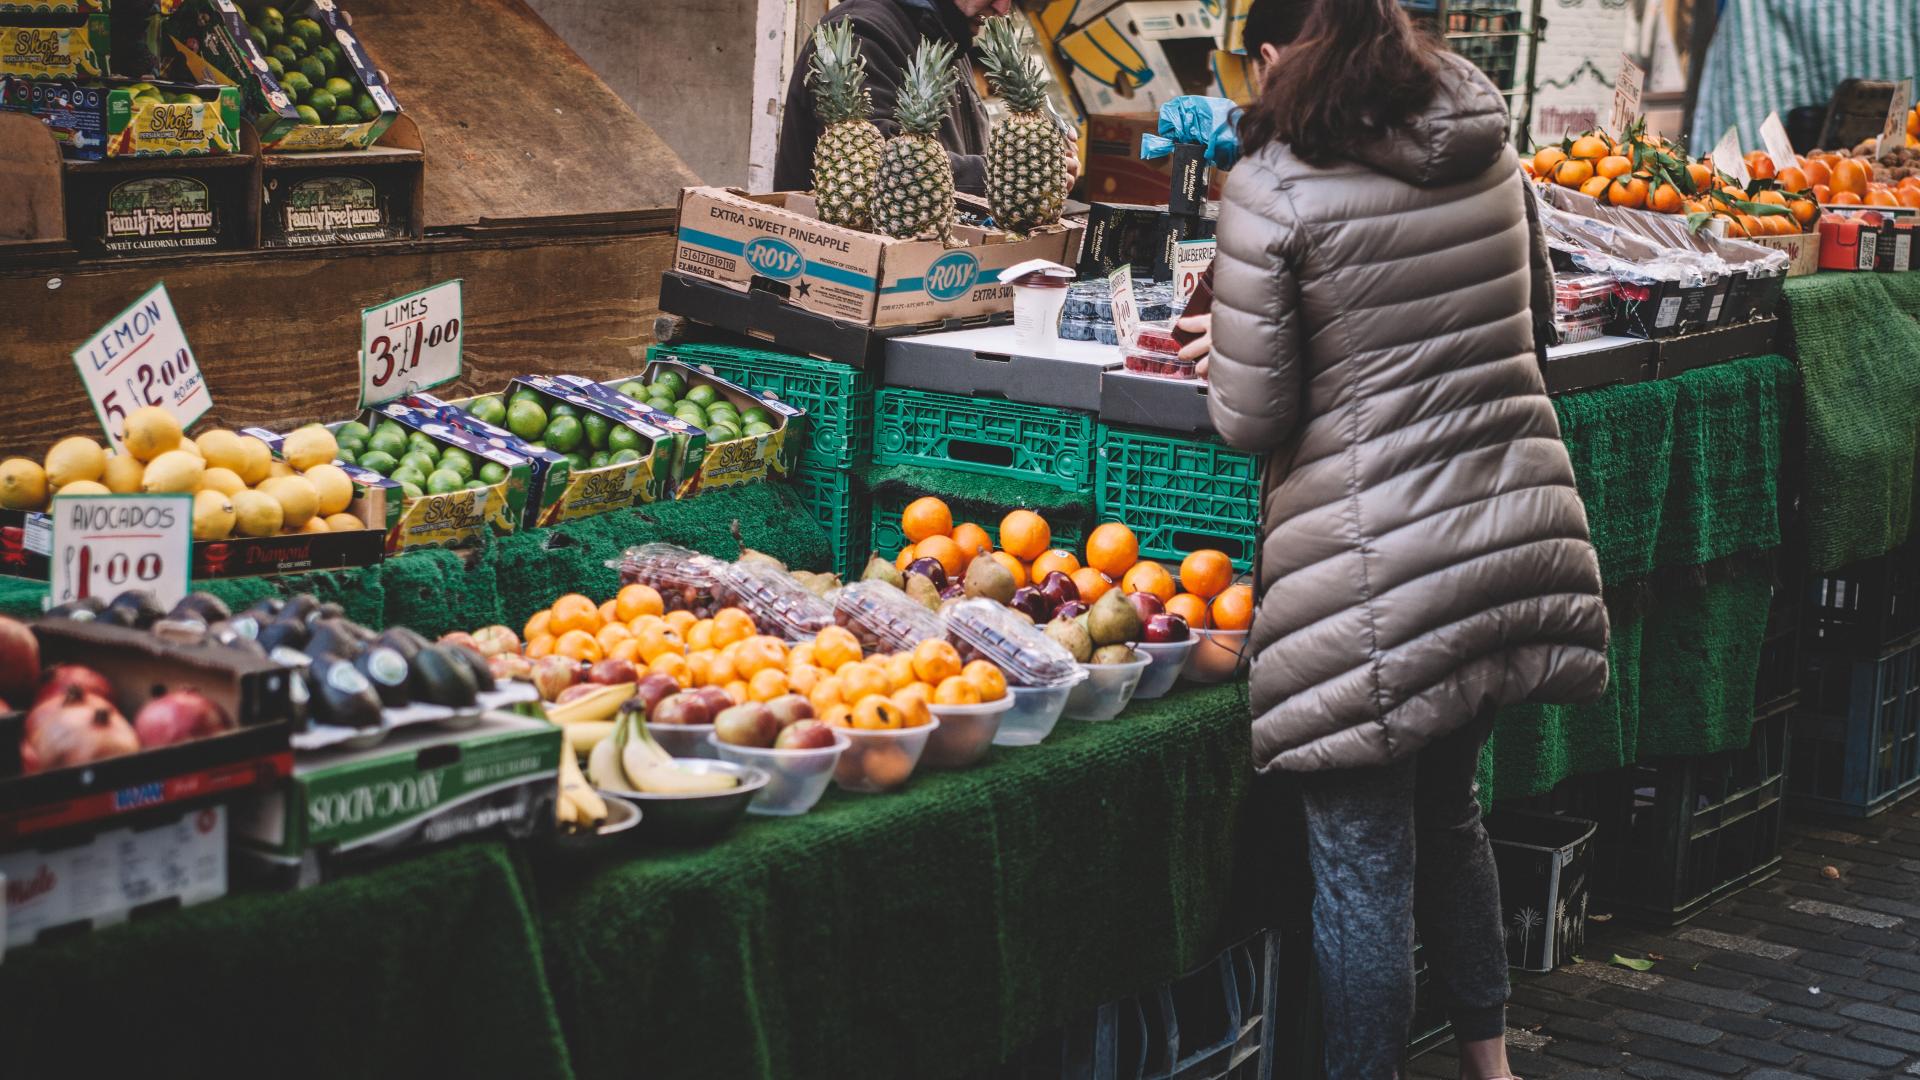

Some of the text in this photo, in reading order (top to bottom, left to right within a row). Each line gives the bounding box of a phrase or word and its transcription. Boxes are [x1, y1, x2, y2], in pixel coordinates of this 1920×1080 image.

[15, 29, 59, 55] Shot
[151, 105, 194, 131] Shot
[1190, 159, 1198, 174] King
[710, 206, 850, 253] EXTRA SWEET PINEAPPLE
[106, 237, 217, 252] SWEET CALIFORNIA CHERRIES
[751, 244, 797, 273] ROSY
[726, 261, 734, 270] 10
[820, 257, 839, 267] PRODUCT
[845, 264, 858, 272] COSTA
[930, 263, 975, 291] ROSY
[972, 285, 1014, 302] EXTRA SW
[384, 297, 428, 327] LIMES
[89, 299, 162, 371] LEMON
[370, 335, 395, 387] 3
[398, 318, 460, 377] £1.00
[102, 390, 127, 442] 5
[72, 504, 176, 531] AVOCADOS
[424, 491, 475, 523] Shot
[308, 769, 445, 832] AVOCADOS
